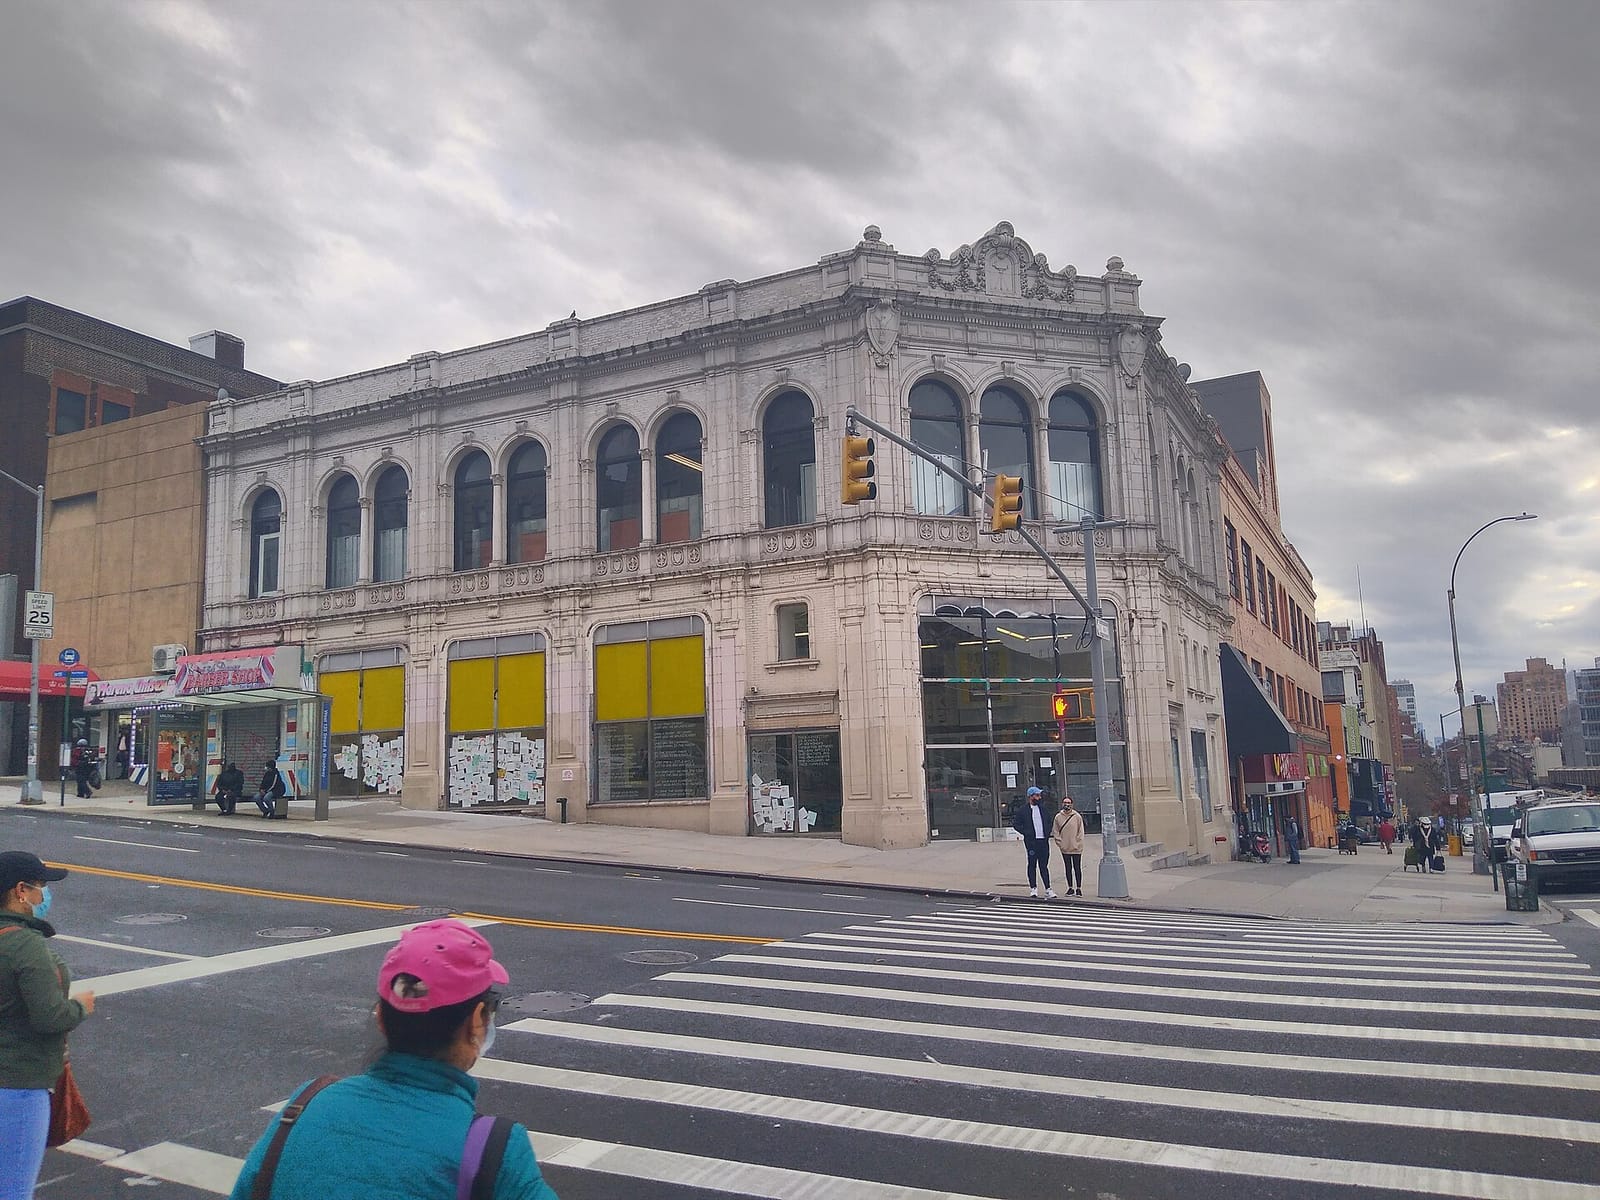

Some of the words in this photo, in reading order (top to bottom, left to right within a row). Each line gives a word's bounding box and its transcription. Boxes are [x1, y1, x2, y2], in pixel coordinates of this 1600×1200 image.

[29, 611, 50, 624] 25
[184, 671, 230, 689] BARBER
[231, 668, 263, 685] SHOP
